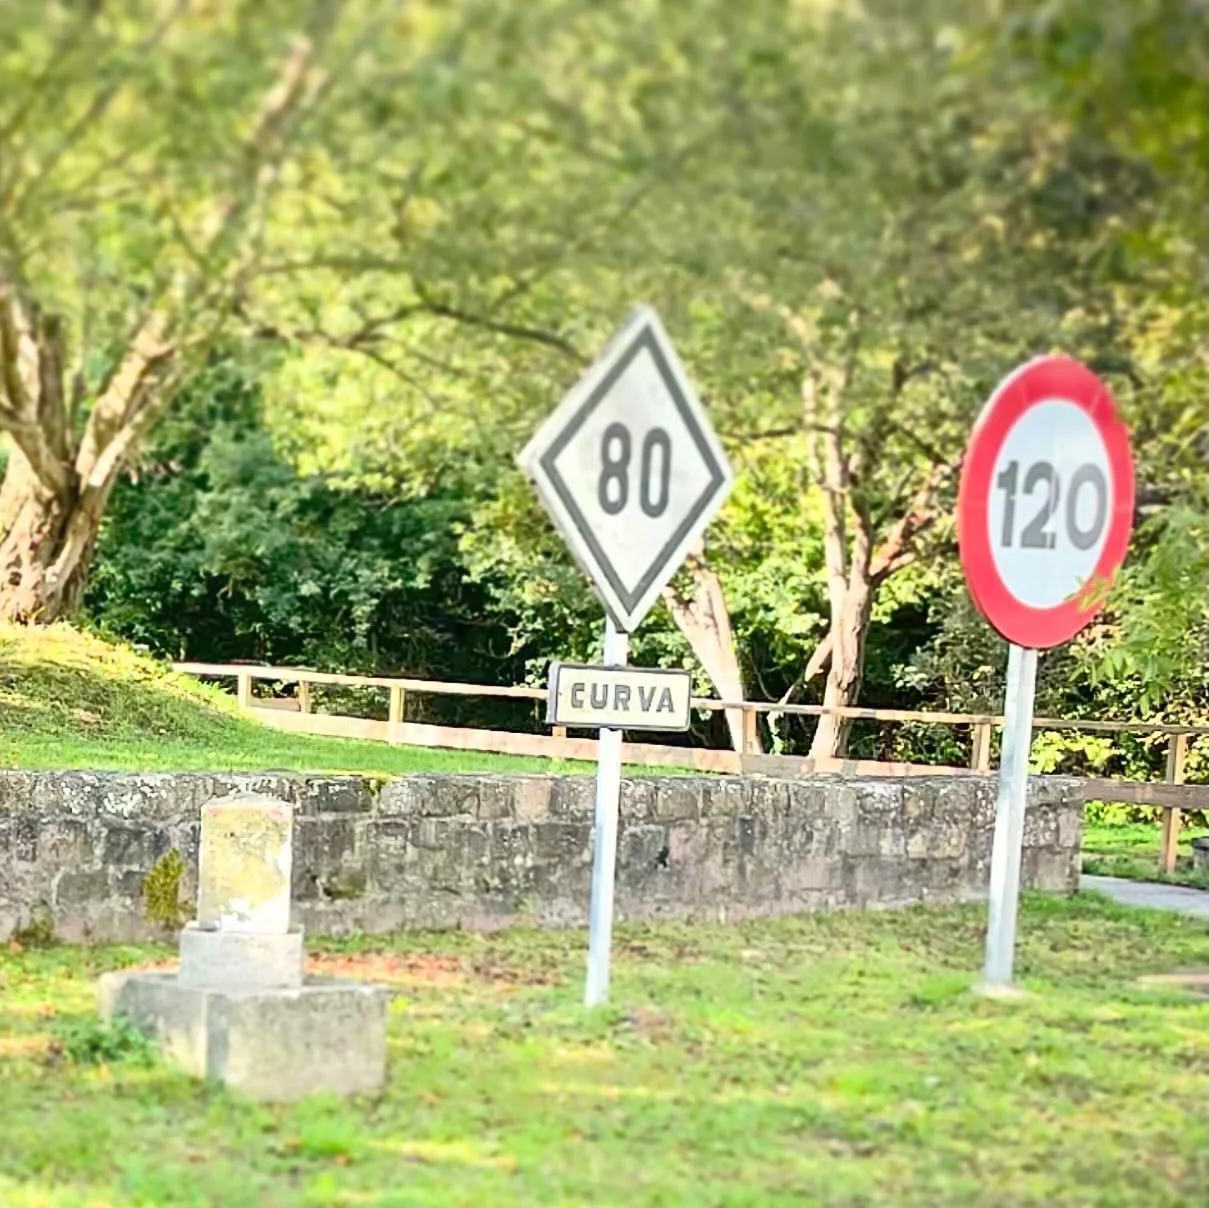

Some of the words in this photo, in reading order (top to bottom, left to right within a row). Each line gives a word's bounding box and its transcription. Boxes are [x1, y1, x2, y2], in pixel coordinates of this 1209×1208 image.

[598, 422, 671, 518] 80
[998, 460, 1108, 551] 120
[571, 683, 675, 712] CURVA
